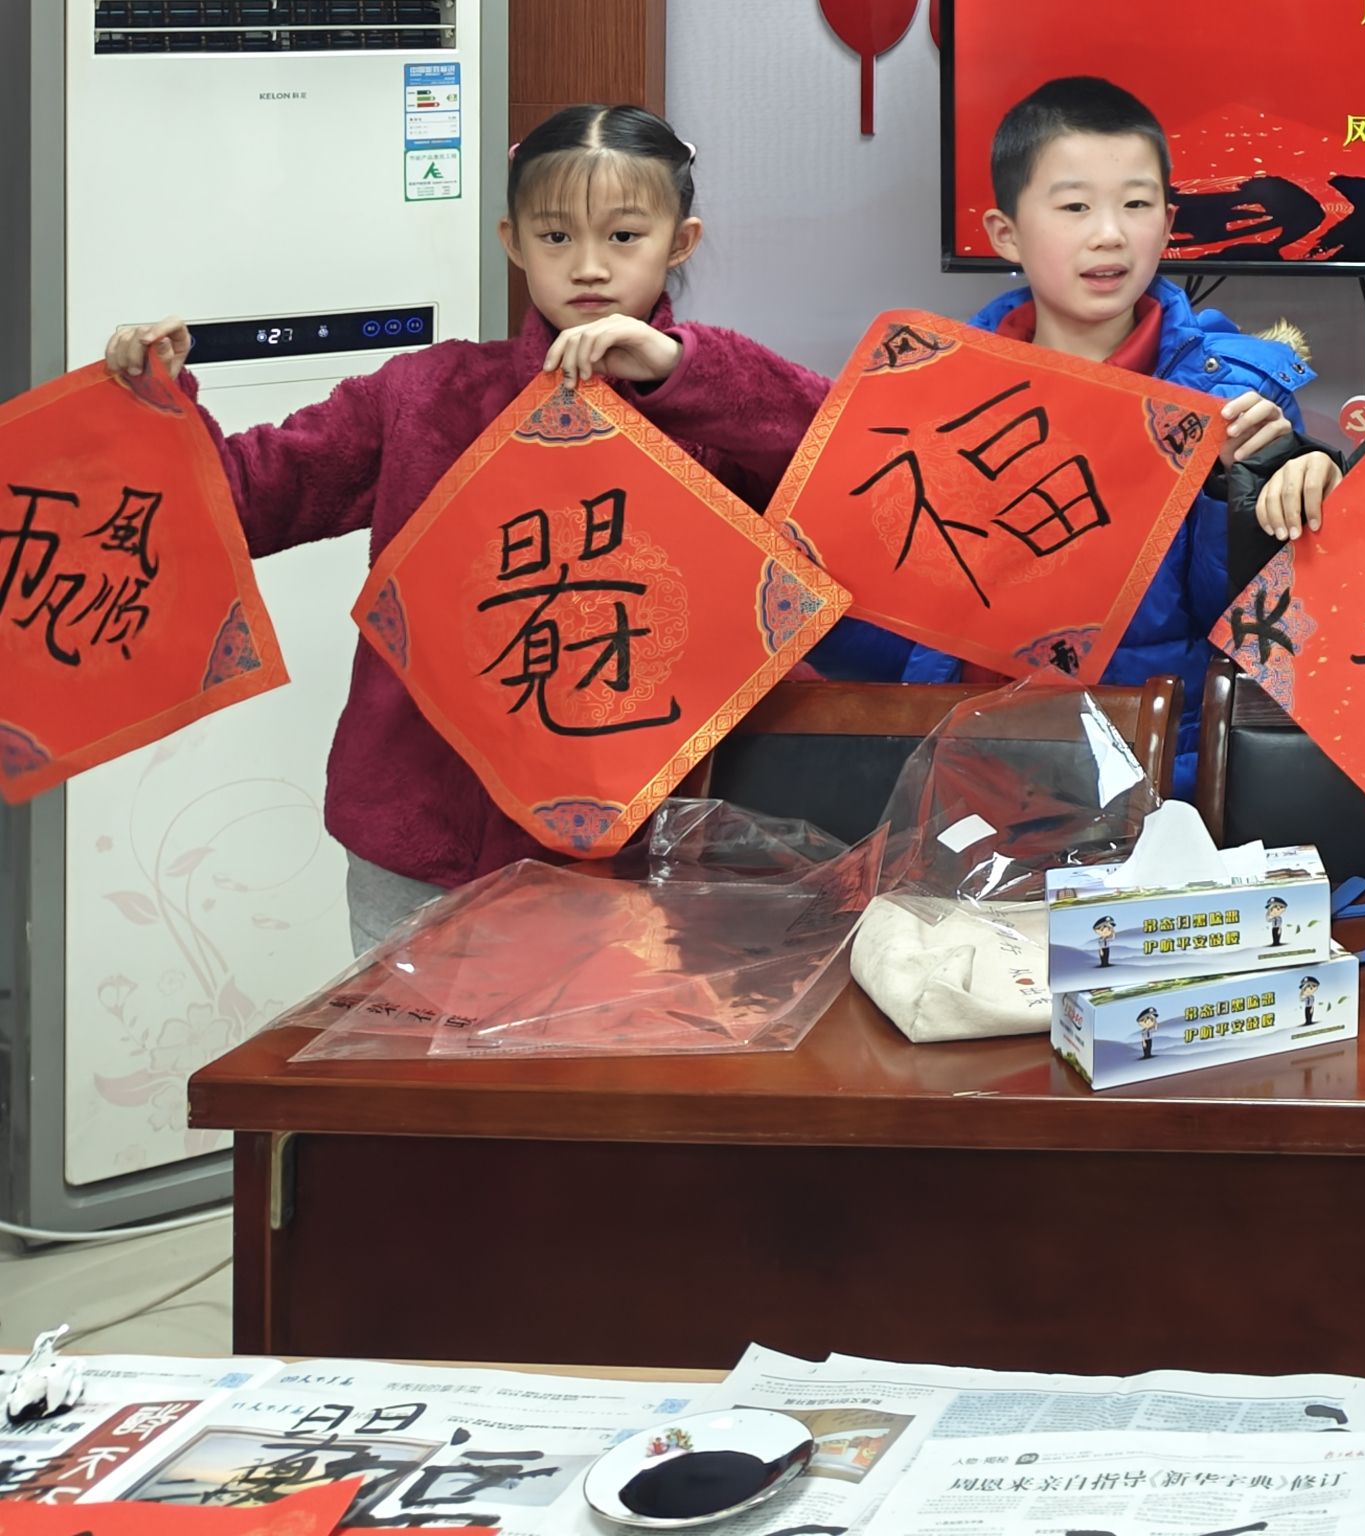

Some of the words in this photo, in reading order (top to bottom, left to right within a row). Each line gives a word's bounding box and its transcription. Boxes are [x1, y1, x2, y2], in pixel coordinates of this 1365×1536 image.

[850, 380, 1112, 609] 福
[946, 1471, 1348, 1492] 周恩来亲自指导《新华字典》修订
